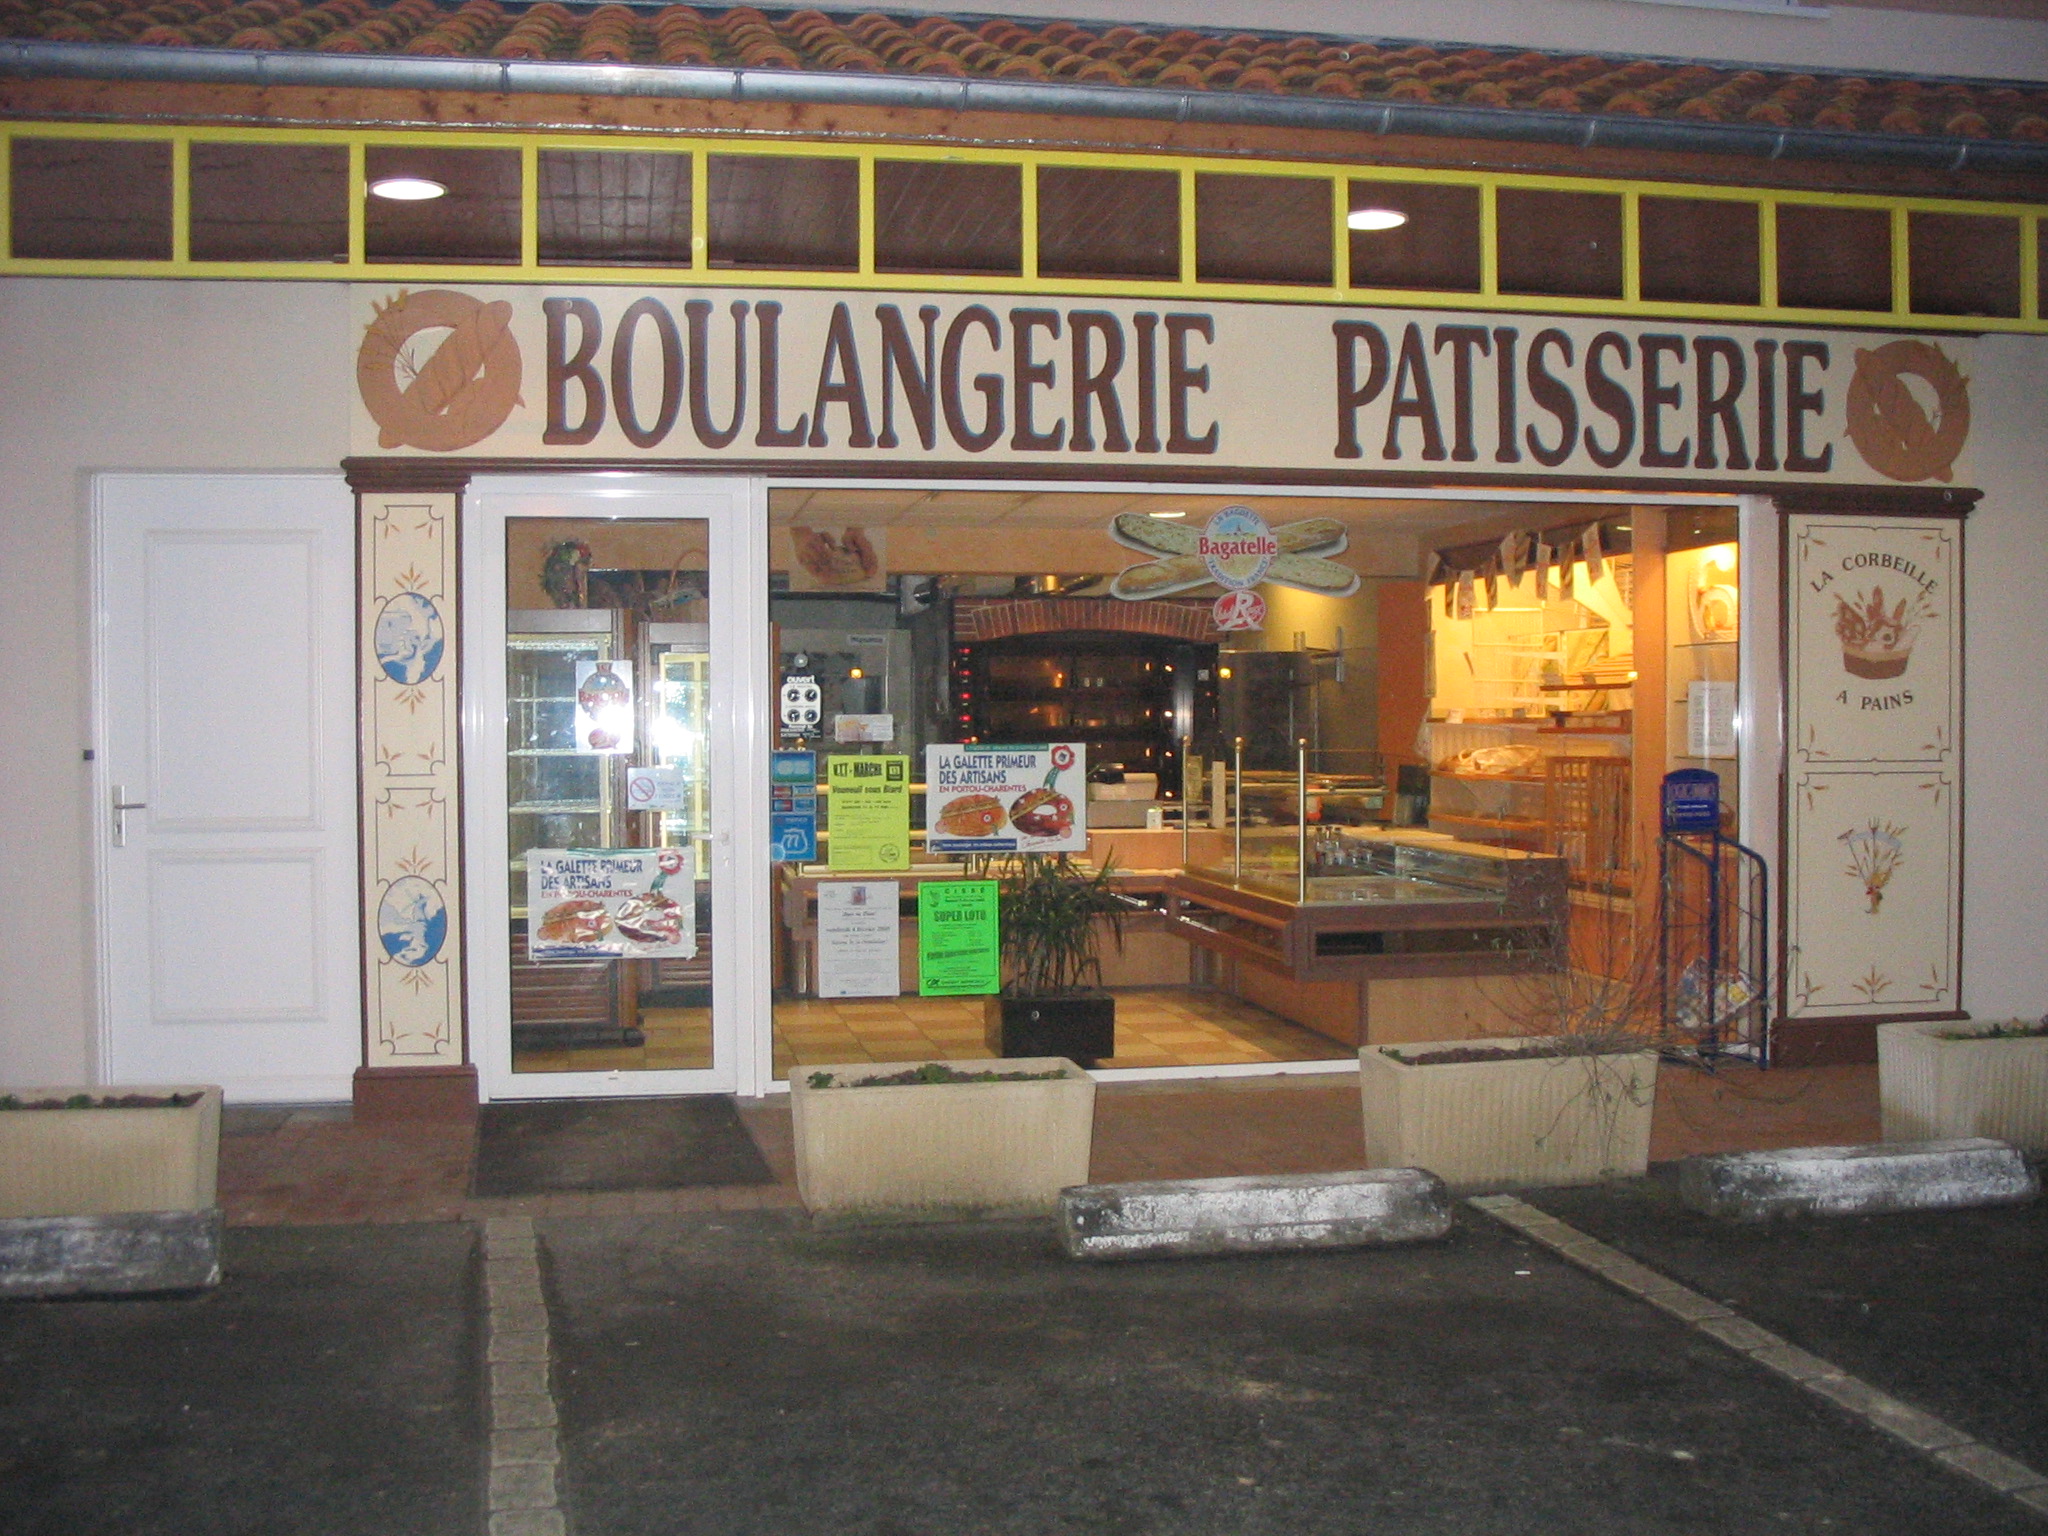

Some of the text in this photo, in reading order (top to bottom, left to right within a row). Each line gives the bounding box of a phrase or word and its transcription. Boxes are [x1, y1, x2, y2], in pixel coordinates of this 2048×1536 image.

[543, 296, 1833, 473] BOULANGERIE PATISSERIE
[1200, 537, 1277, 560] Bagatelle
[1810, 553, 1938, 594] LA CORBEILLE
[1836, 690, 1914, 710] A PAINS
[939, 755, 1036, 769] LA GALETTE PRIMEUR
[940, 770, 1006, 784] DES ARTISANS
[951, 784, 1027, 793] POITOU-CHARENTES
[556, 860, 597, 873] GALETTE
